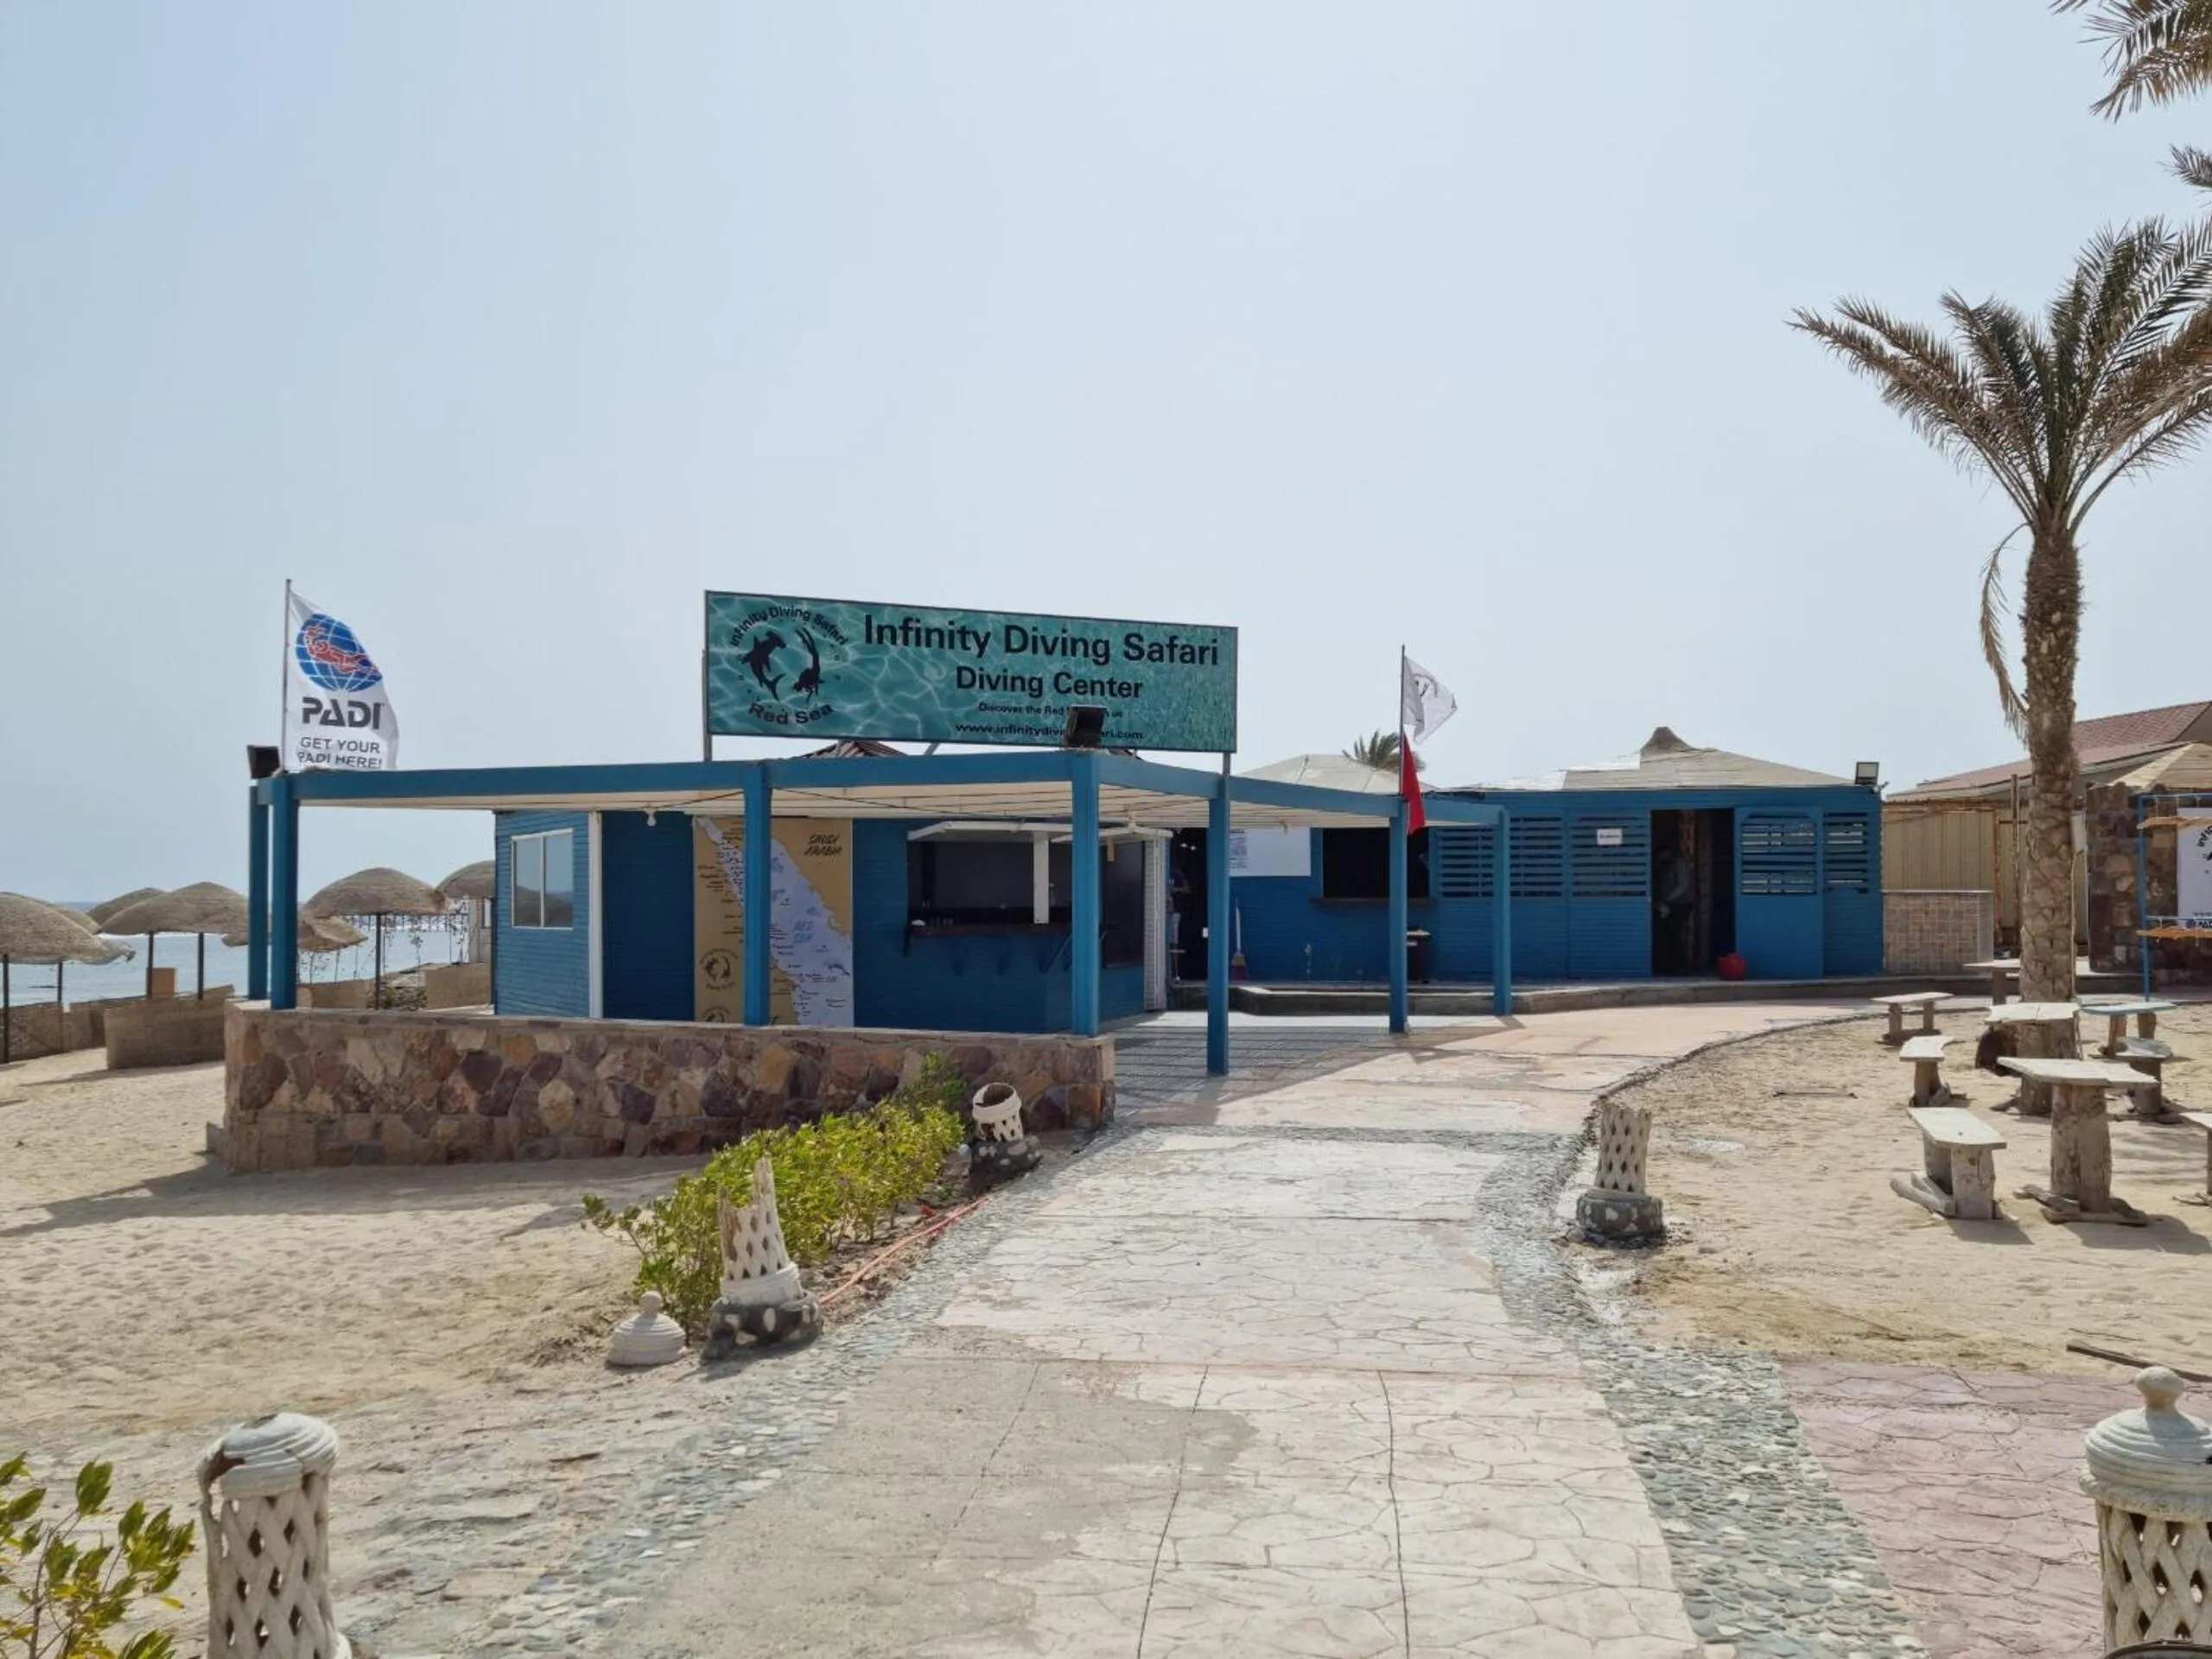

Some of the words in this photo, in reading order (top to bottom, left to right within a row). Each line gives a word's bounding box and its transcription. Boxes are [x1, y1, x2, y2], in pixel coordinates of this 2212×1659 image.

[730, 608, 769, 646] Infinity
[768, 605, 811, 621] Diving
[813, 613, 849, 645] Safari
[864, 614, 992, 658] Infinity
[1004, 625, 1111, 666] Diving
[1123, 632, 1219, 665] Safari
[956, 665, 1044, 698] Diving
[1052, 671, 1144, 698] Center
[302, 696, 381, 730] PADI
[749, 702, 788, 724] Red
[794, 703, 834, 724] Sea
[978, 702, 1023, 715] Discover
[1026, 705, 1041, 715] the
[1044, 705, 1065, 716] Red
[300, 736, 332, 749] GET
[338, 739, 380, 753] YOUR
[335, 753, 382, 768] HERE!
